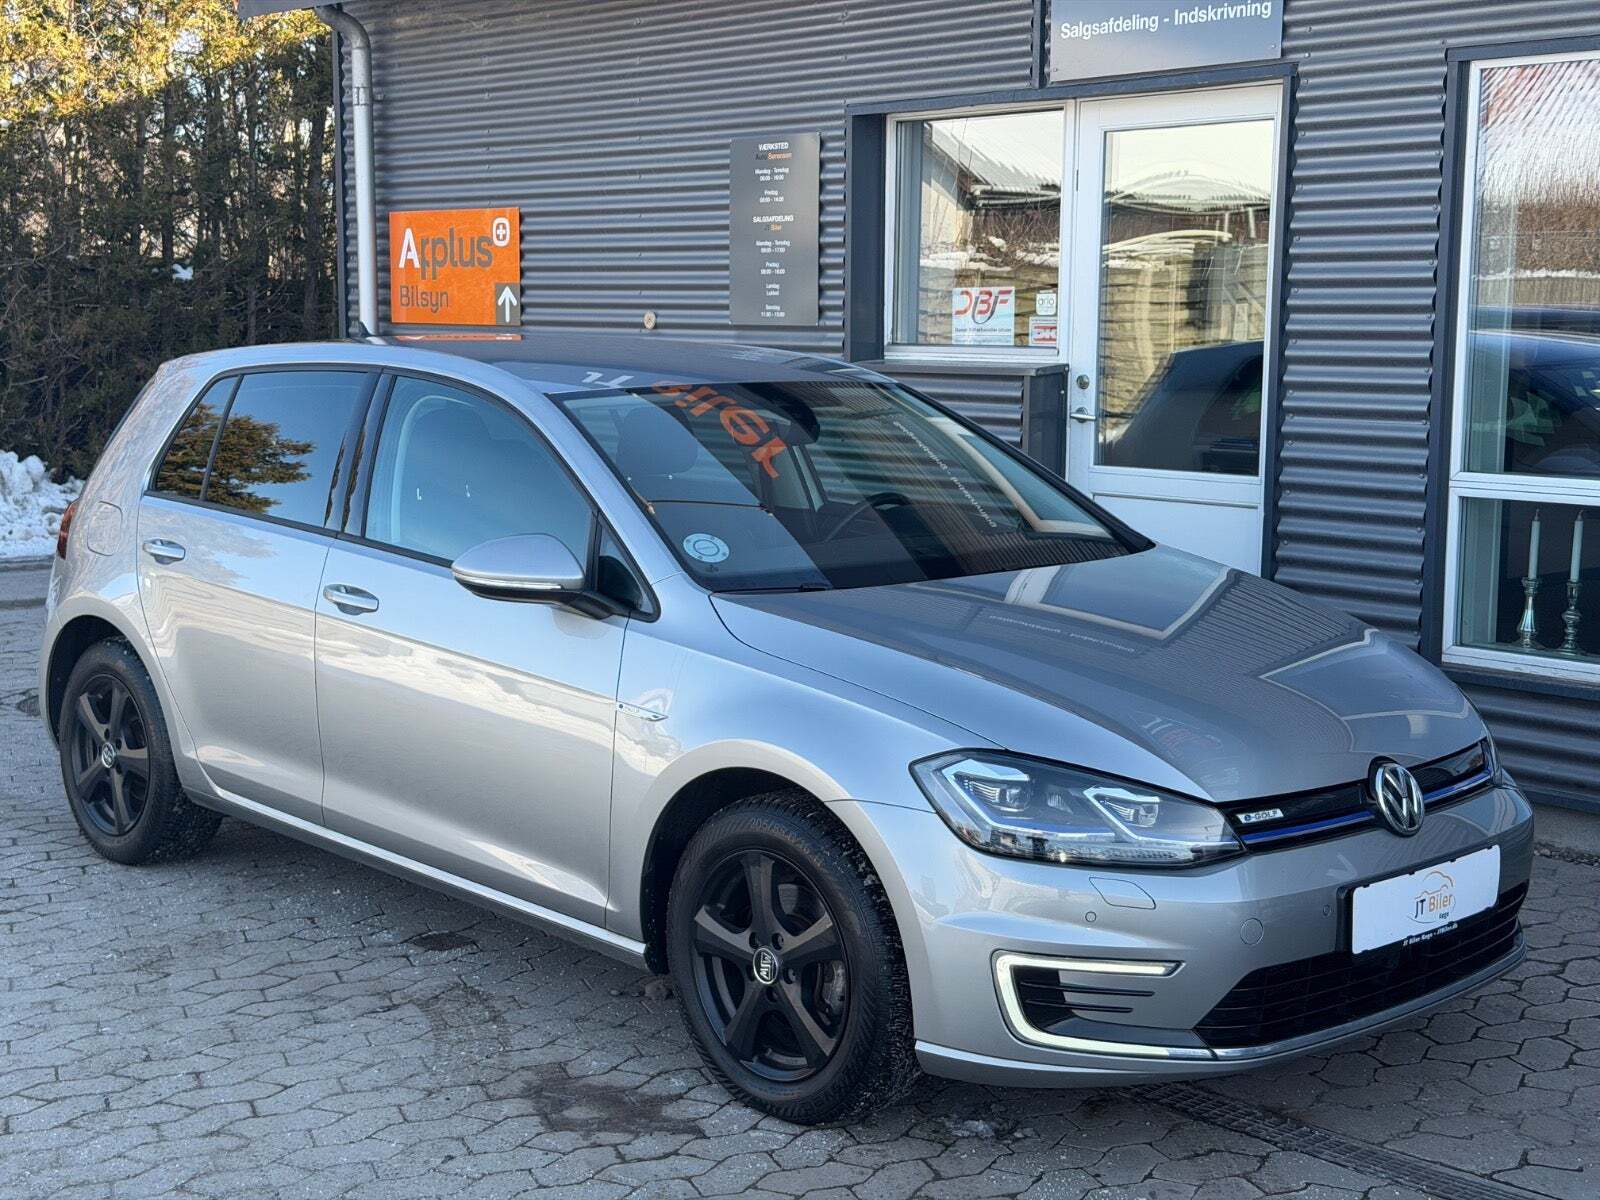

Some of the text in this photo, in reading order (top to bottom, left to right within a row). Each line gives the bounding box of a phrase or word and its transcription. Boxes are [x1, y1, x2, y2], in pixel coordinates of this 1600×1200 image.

[1060, 14, 1159, 41] Salgsafdeling
[1174, 0, 1273, 26] Indskrivning
[400, 285, 449, 314] Bilsyn
[1414, 893, 1453, 919] JT Biler
